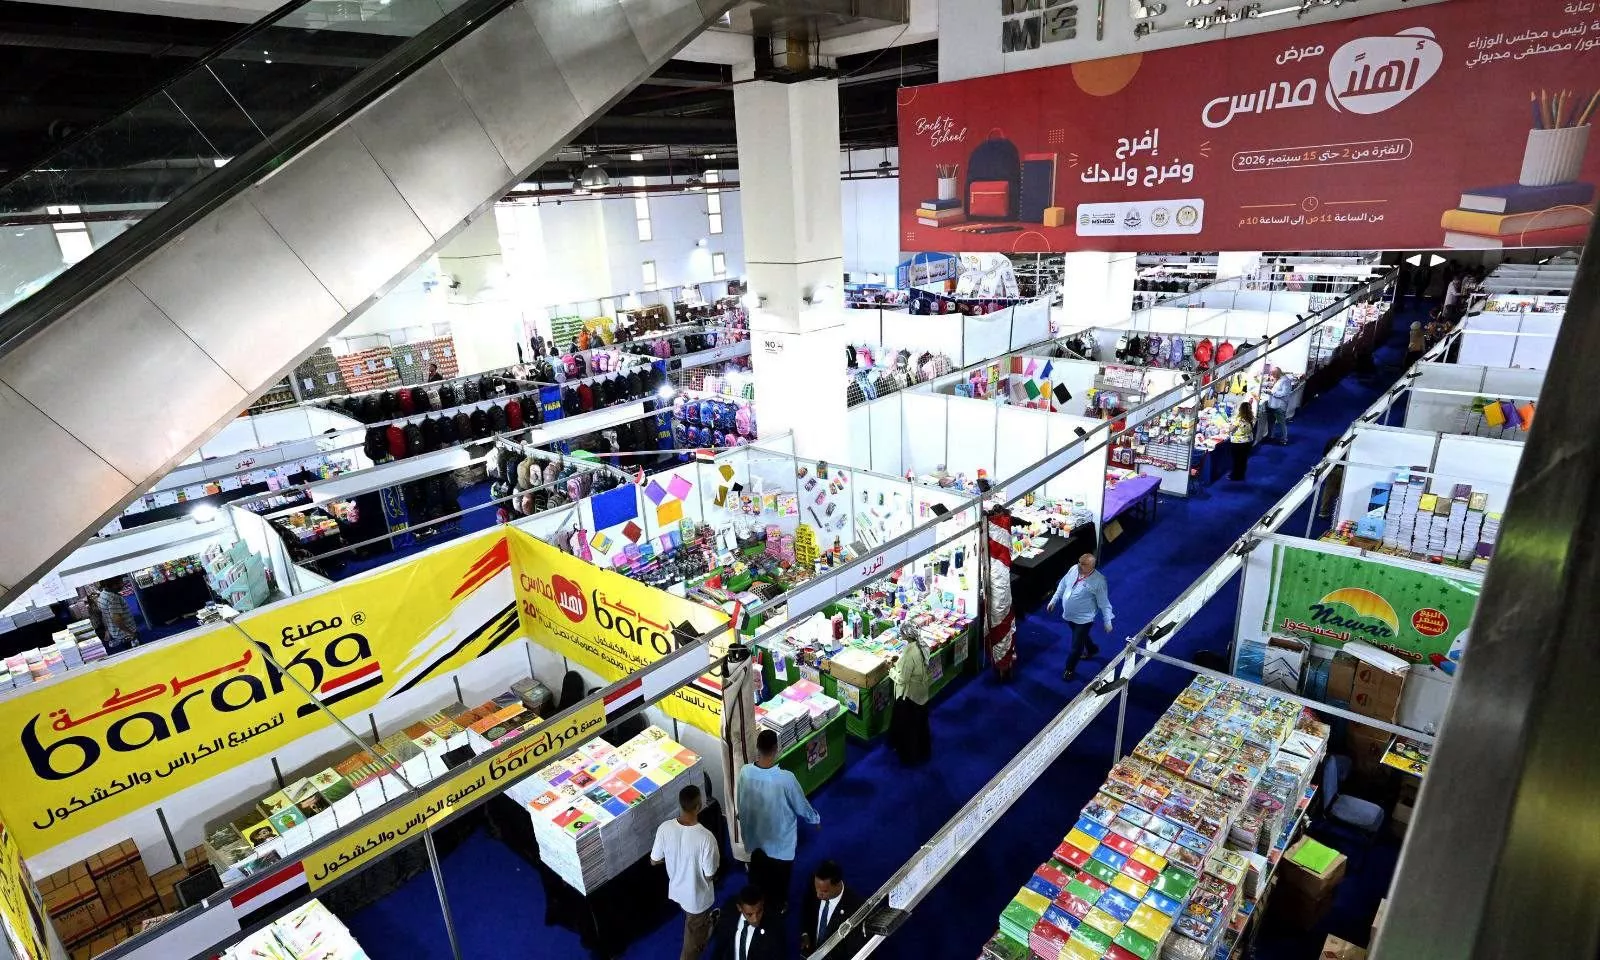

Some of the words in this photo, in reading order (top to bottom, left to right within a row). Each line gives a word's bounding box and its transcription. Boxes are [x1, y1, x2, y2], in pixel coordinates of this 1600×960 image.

[1564, 2, 1595, 15] رعاية
[1506, 30, 1548, 45] مجلس
[1552, 22, 1587, 38] رئيس
[1467, 33, 1503, 49] الوزراء
[1275, 45, 1325, 65] معرض
[1513, 42, 1571, 60] مصطفى
[1465, 51, 1511, 68] مدبولي
[1201, 78, 1317, 128] مدارس
[915, 115, 943, 135] Back
[943, 116, 955, 131] to
[930, 128, 967, 147] School
[1115, 128, 1159, 159] إفرح
[1302, 151, 1316, 160] 15
[1318, 151, 1340, 162] حتى
[1342, 149, 1349, 158] 2
[1352, 150, 1369, 160] من
[1372, 144, 1404, 158] الفترة
[1238, 156, 1265, 166] 2026
[1266, 155, 1301, 168] سبتمبر
[1080, 161, 1138, 187] ولادك
[1143, 158, 1194, 187] وفرح
[1246, 217, 1258, 225] 10
[1259, 215, 1289, 225] الساعة
[1290, 215, 1304, 226] إلى
[1305, 216, 1319, 225] ص
[1320, 215, 1333, 223] 11
[1334, 213, 1367, 222] الساعة
[1369, 213, 1384, 223] من
[520, 573, 554, 601] مدارس
[281, 614, 343, 647] مصنع
[21, 632, 373, 781] baraka
[227, 711, 285, 746] لتصنيع
[580, 716, 603, 732] مصنع
[156, 736, 225, 779] الكراس
[488, 724, 578, 781] baraka
[445, 775, 487, 807] لتصنيع
[33, 768, 153, 831] والكشكول
[397, 799, 445, 836] الكراس
[314, 831, 396, 881] والكشكول
